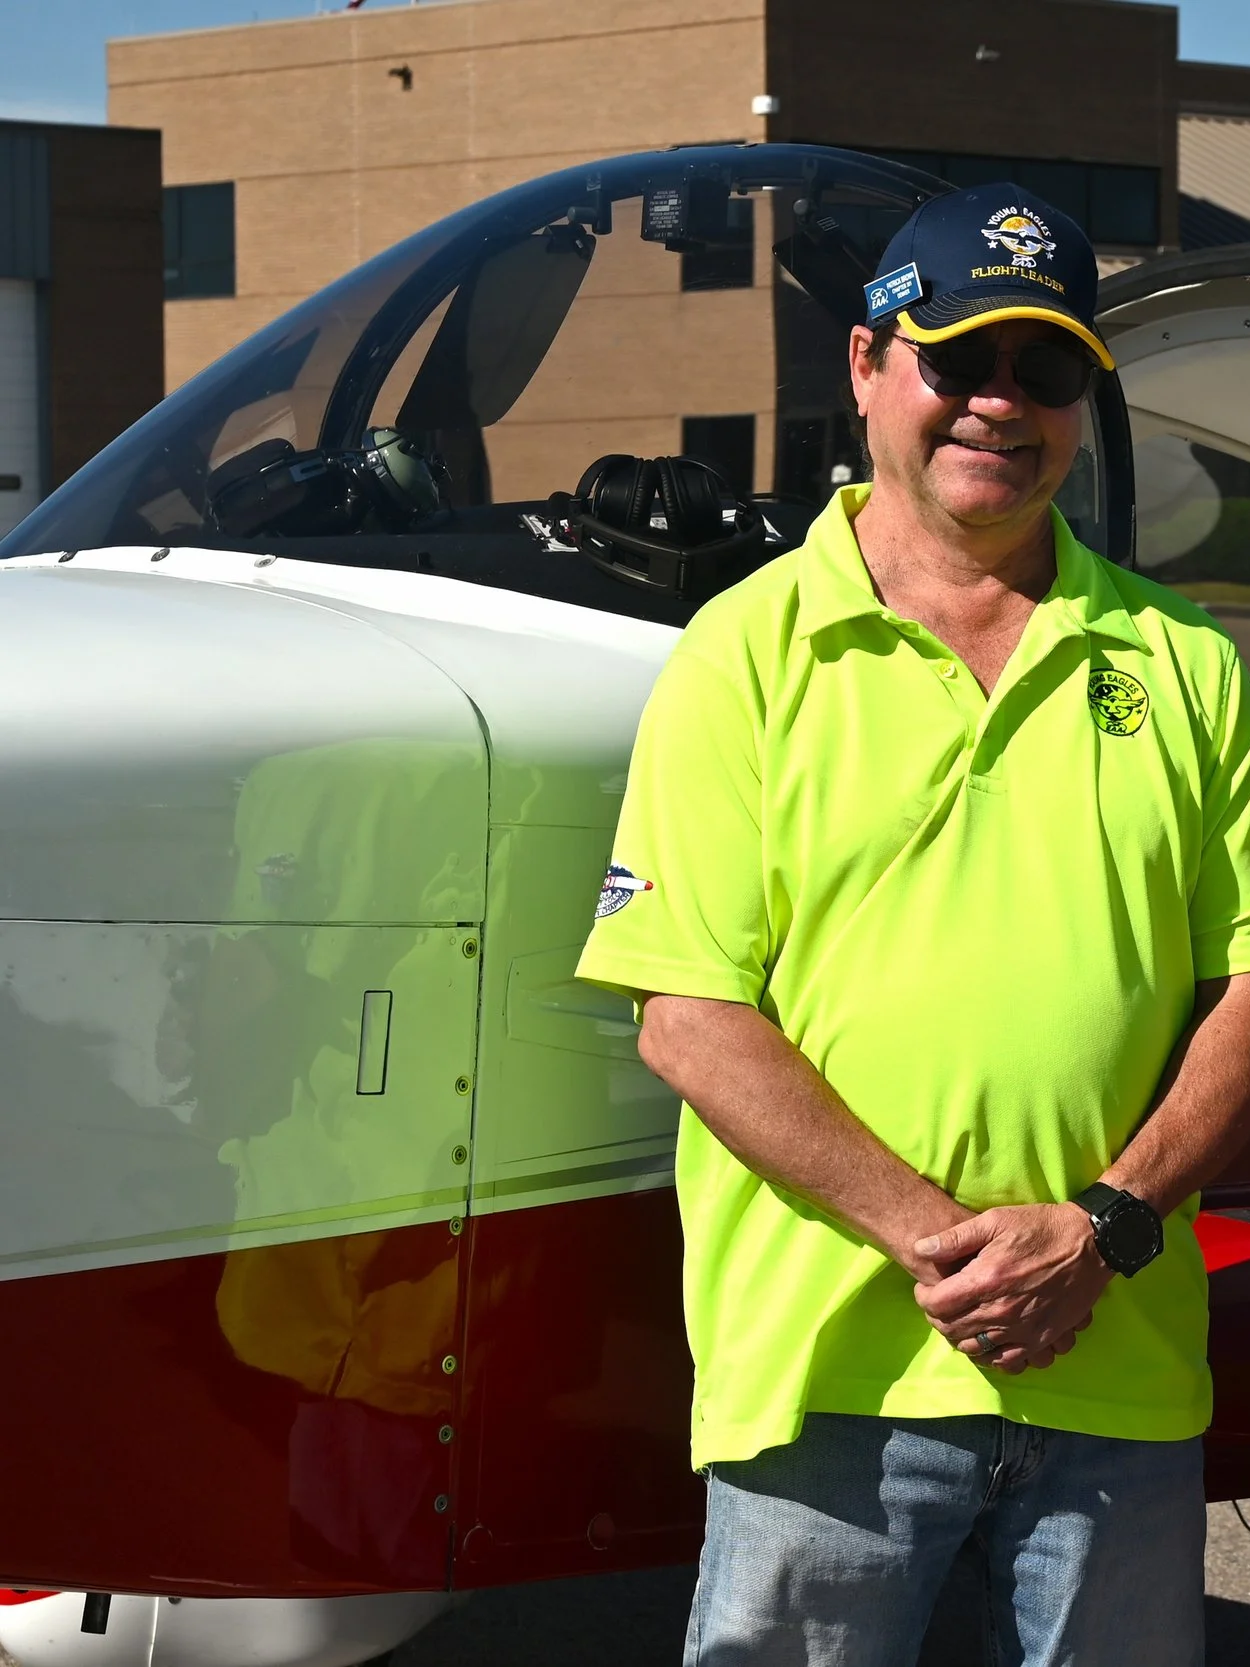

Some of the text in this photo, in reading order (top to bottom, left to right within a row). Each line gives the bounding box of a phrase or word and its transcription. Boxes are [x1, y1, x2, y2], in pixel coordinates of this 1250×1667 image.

[987, 206, 1052, 237] YOUNG EAGLES
[971, 265, 1065, 295] FLIGHT LEADER
[872, 295, 887, 311] EAA
[1107, 674, 1139, 694] EAGLES
[602, 892, 631, 914] CHAPTER
